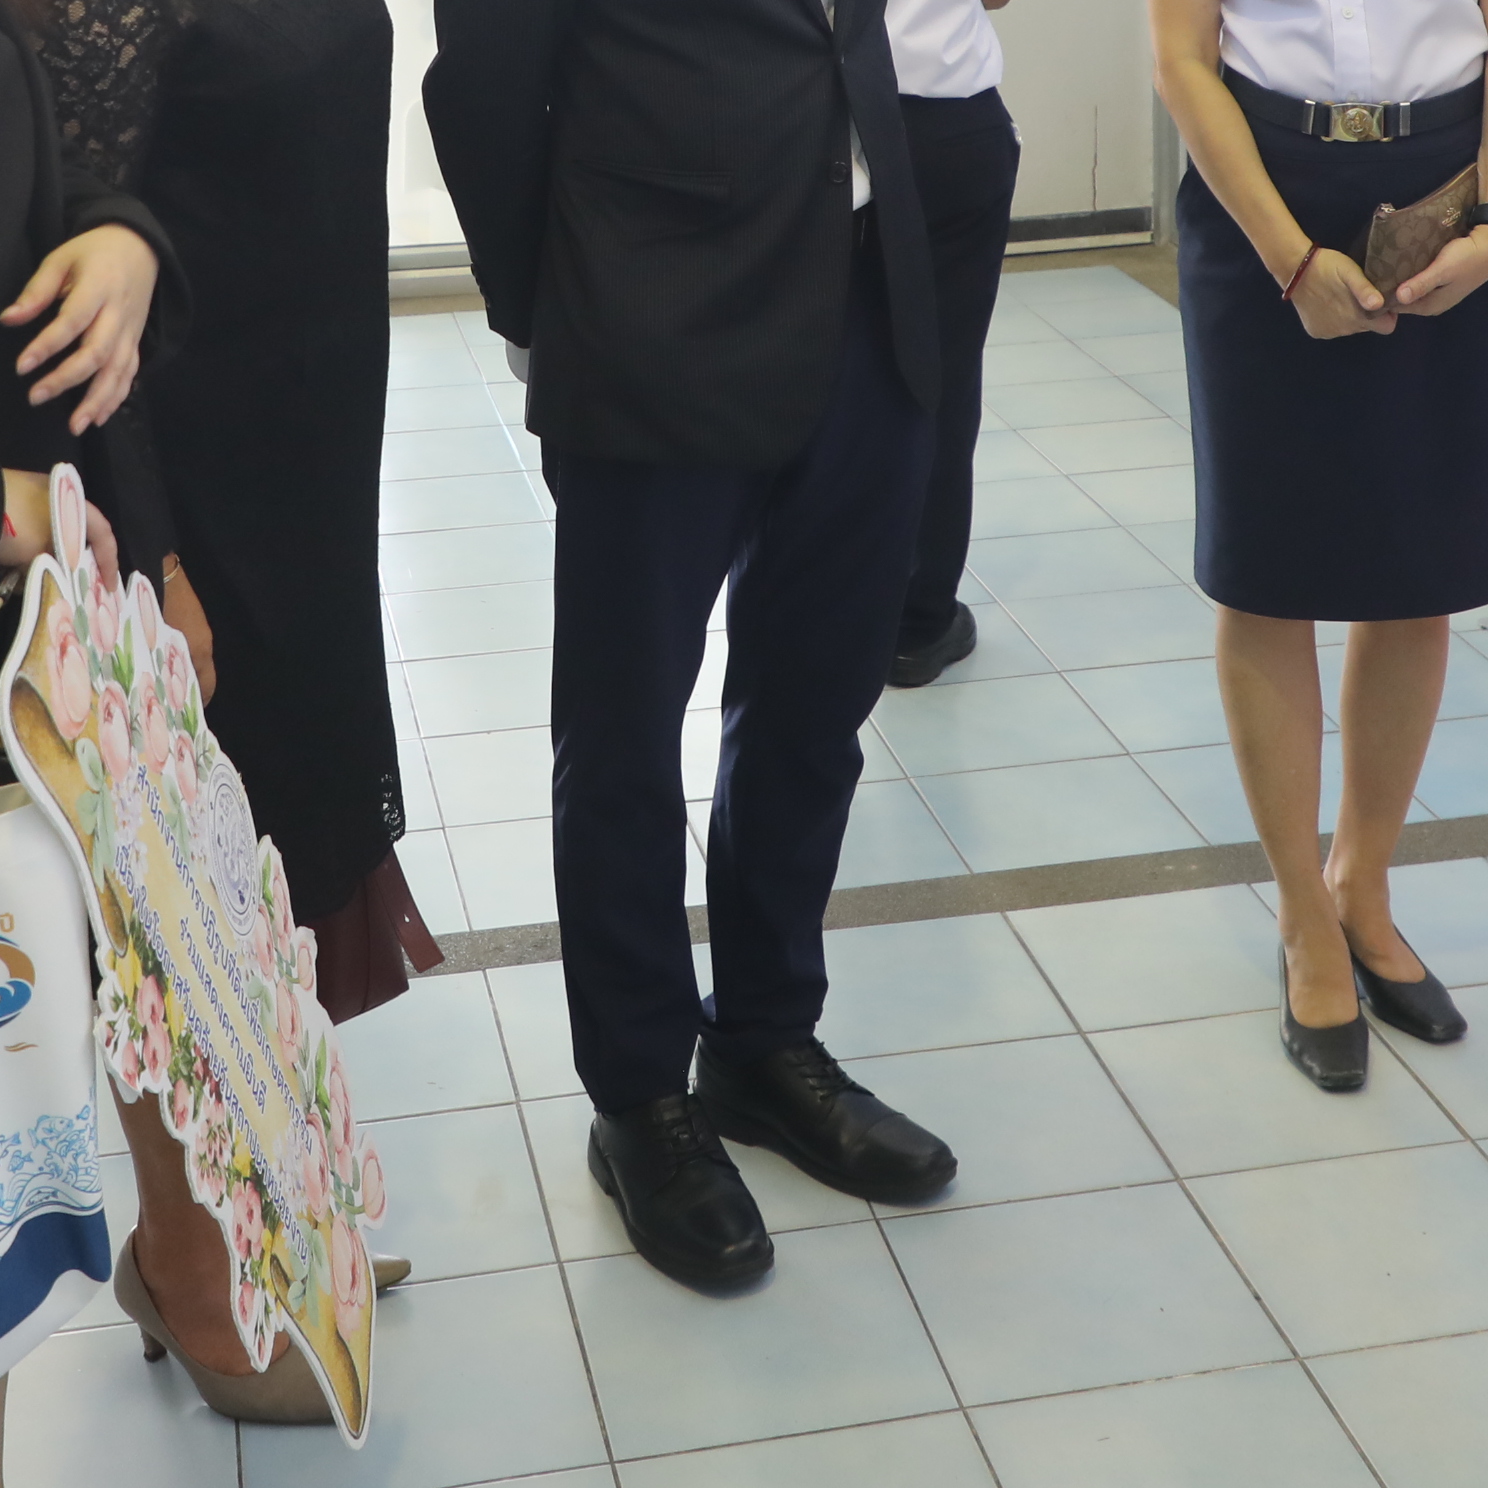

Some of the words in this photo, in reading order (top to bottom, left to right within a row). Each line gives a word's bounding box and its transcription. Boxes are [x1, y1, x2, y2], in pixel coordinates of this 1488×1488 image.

[180, 916, 268, 1114] ร่วมแสดงความยินดี
